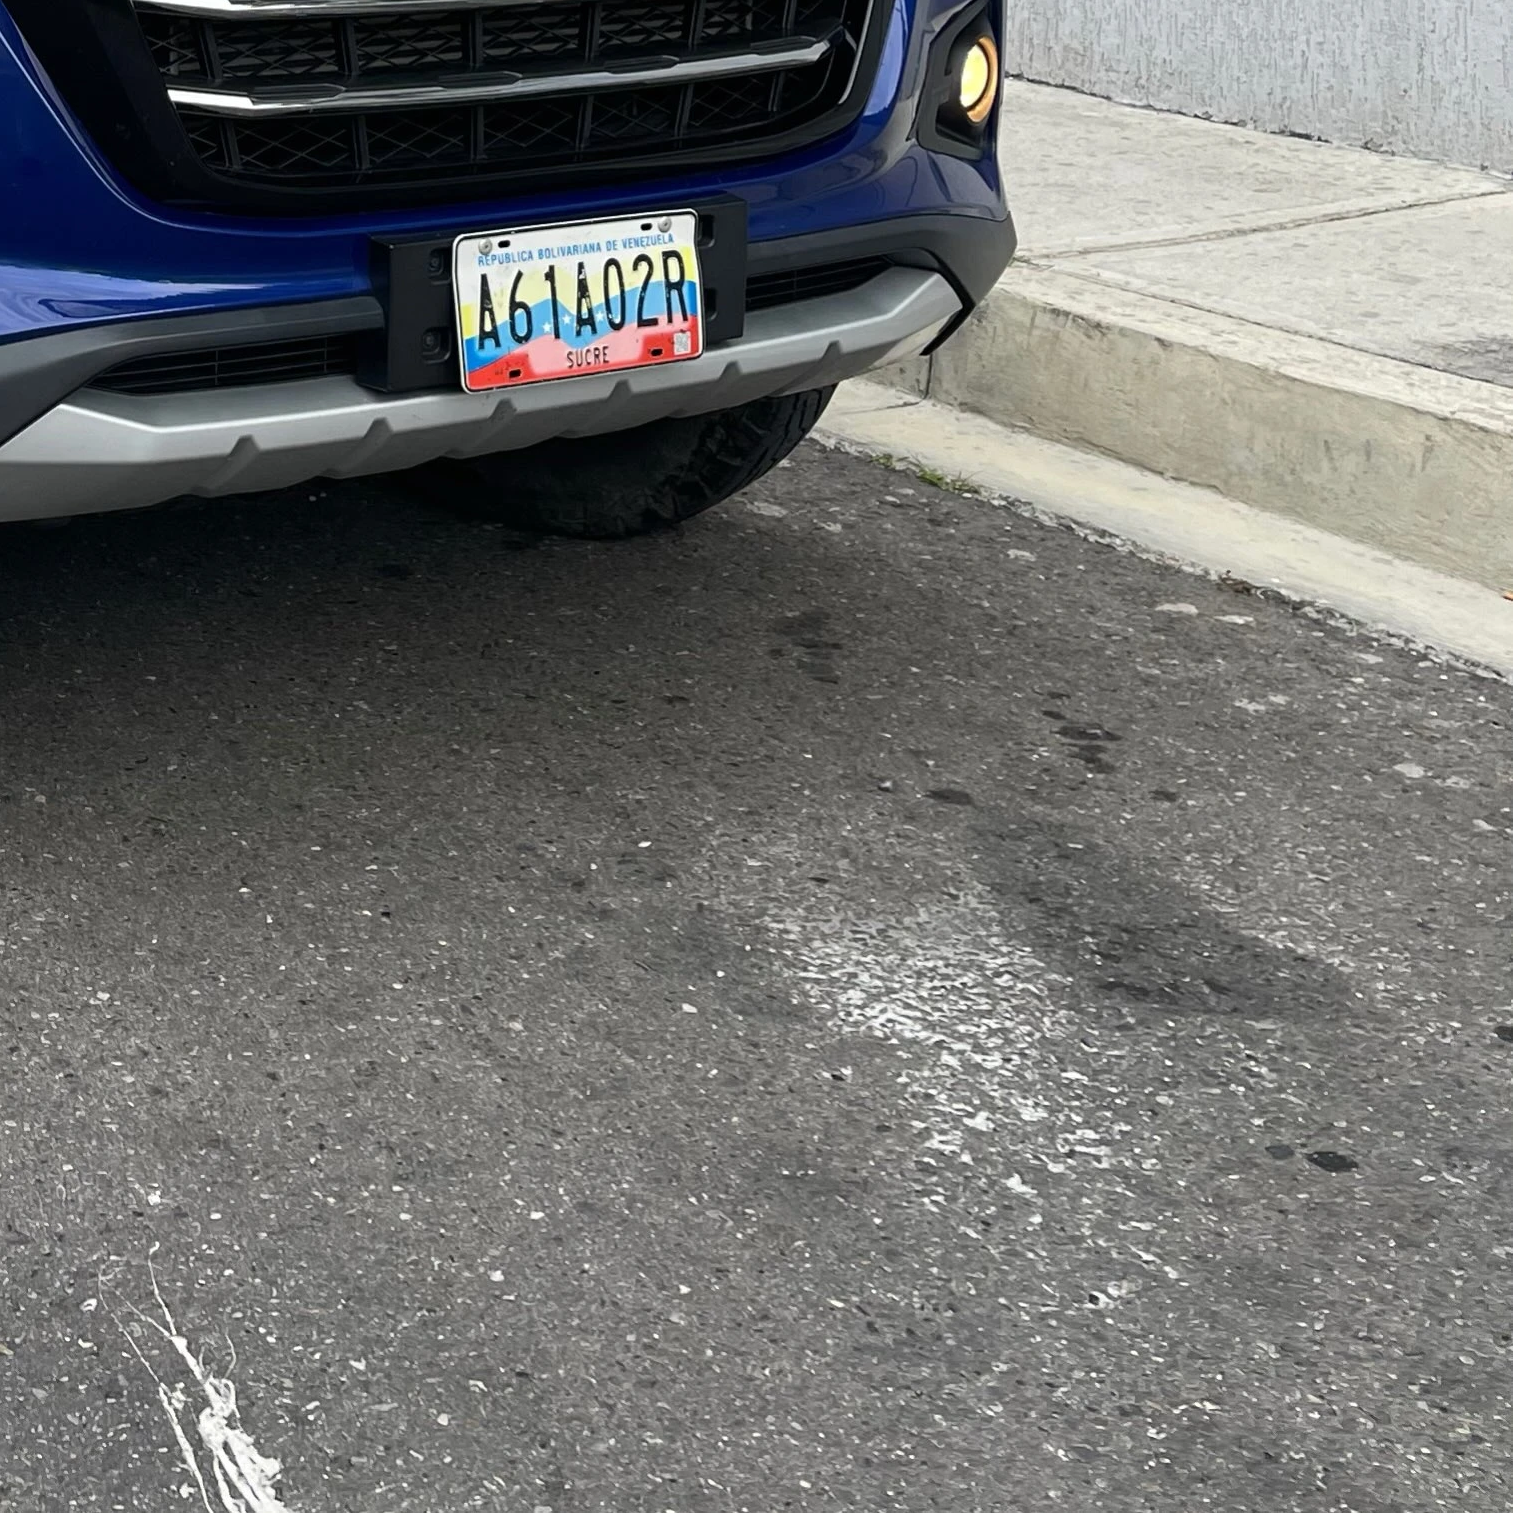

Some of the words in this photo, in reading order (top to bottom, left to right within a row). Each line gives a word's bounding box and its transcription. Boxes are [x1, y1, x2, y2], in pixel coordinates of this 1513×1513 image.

[477, 249, 534, 267] REPUBLICA
[537, 242, 602, 259] BOLIVARIANA
[605, 240, 619, 251] DE
[622, 233, 675, 249] VENEZUELA
[478, 250, 688, 350] A61A02R
[566, 345, 611, 369] SUCRE
